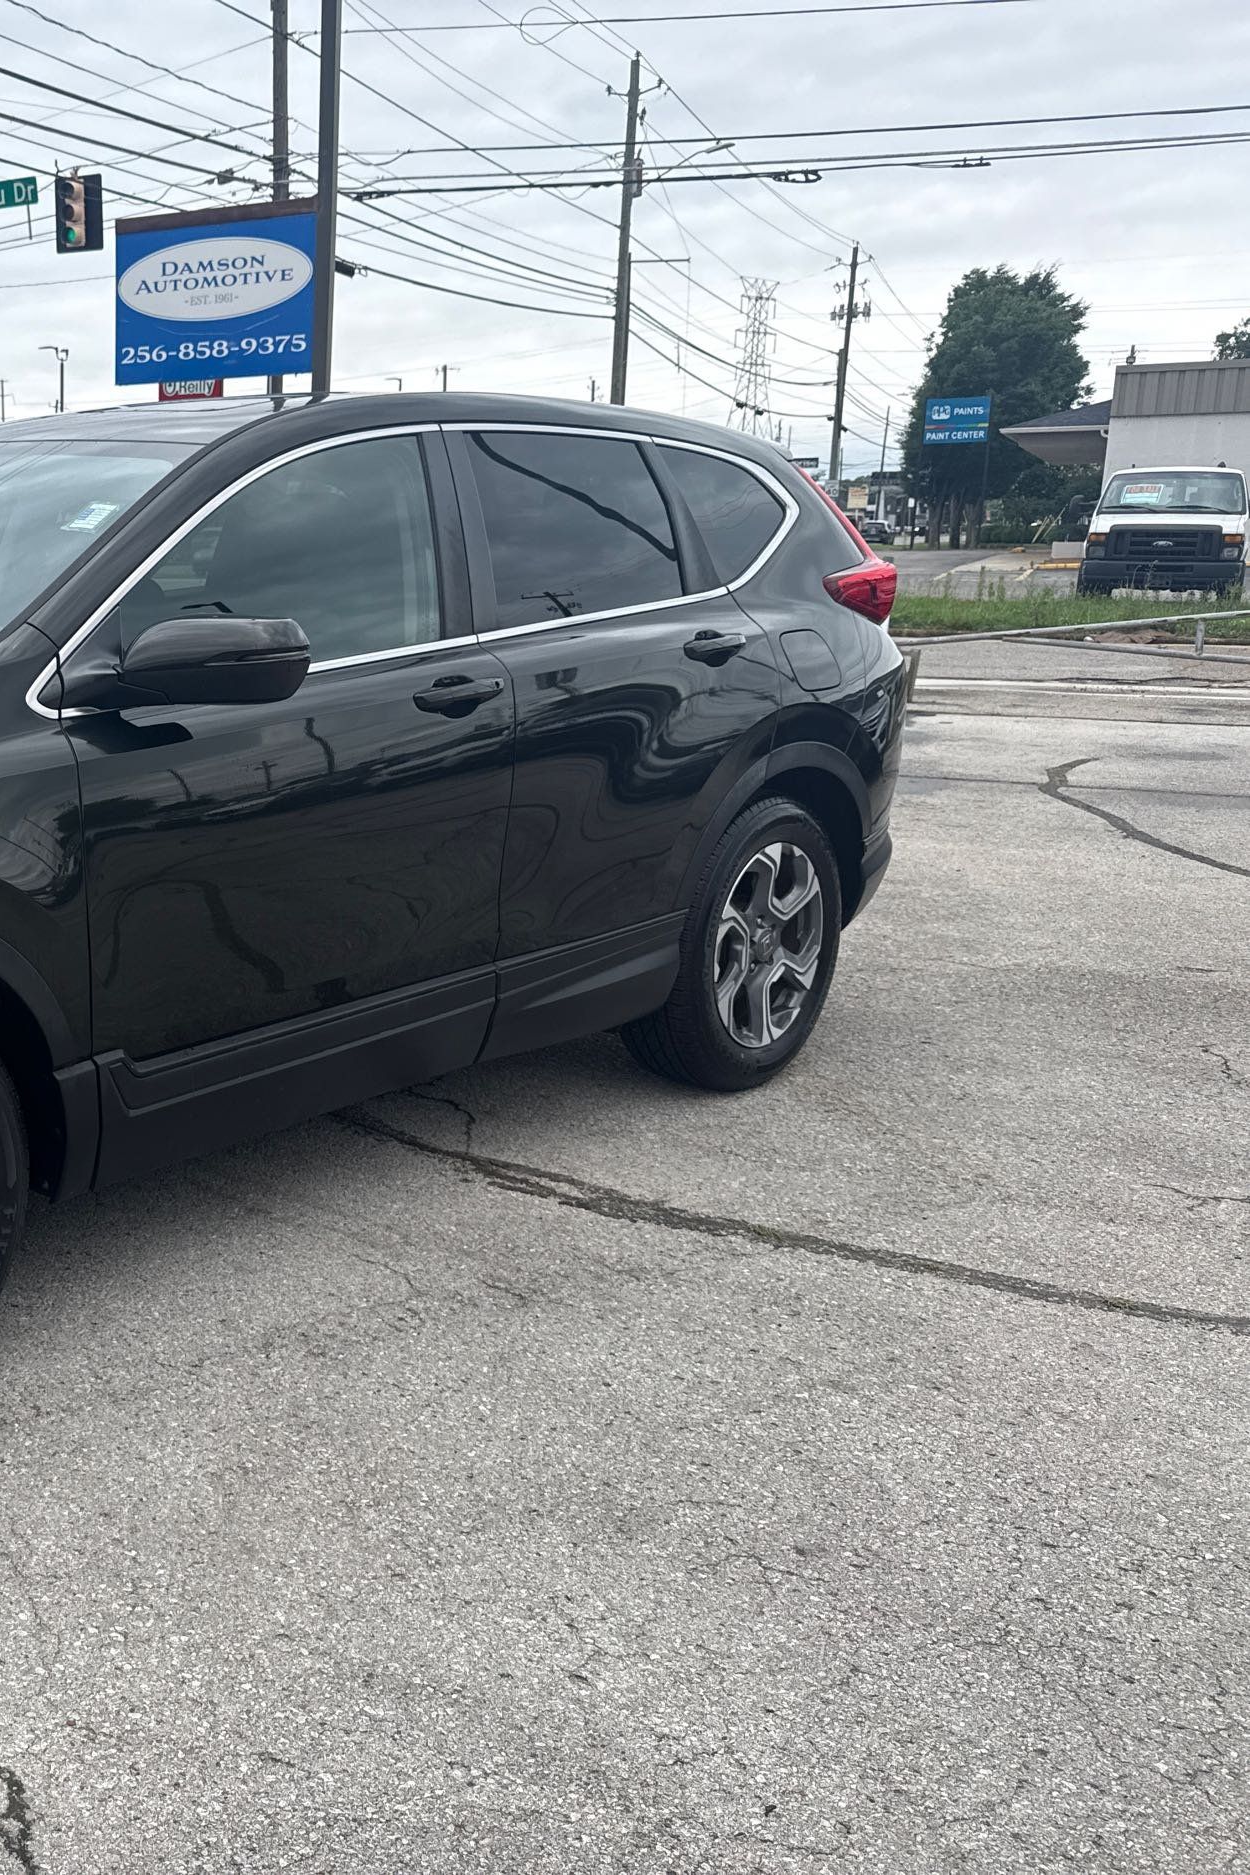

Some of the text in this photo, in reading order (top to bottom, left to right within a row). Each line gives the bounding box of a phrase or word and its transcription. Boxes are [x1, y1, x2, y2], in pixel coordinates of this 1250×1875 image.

[13, 182, 35, 203] Dr
[161, 255, 266, 277] DAMSON
[135, 269, 294, 295] AUTOMOTIVE
[121, 333, 307, 365] 256-858-9375
[953, 406, 984, 416] PAINTS
[925, 430, 985, 441] PAINT CENTER
